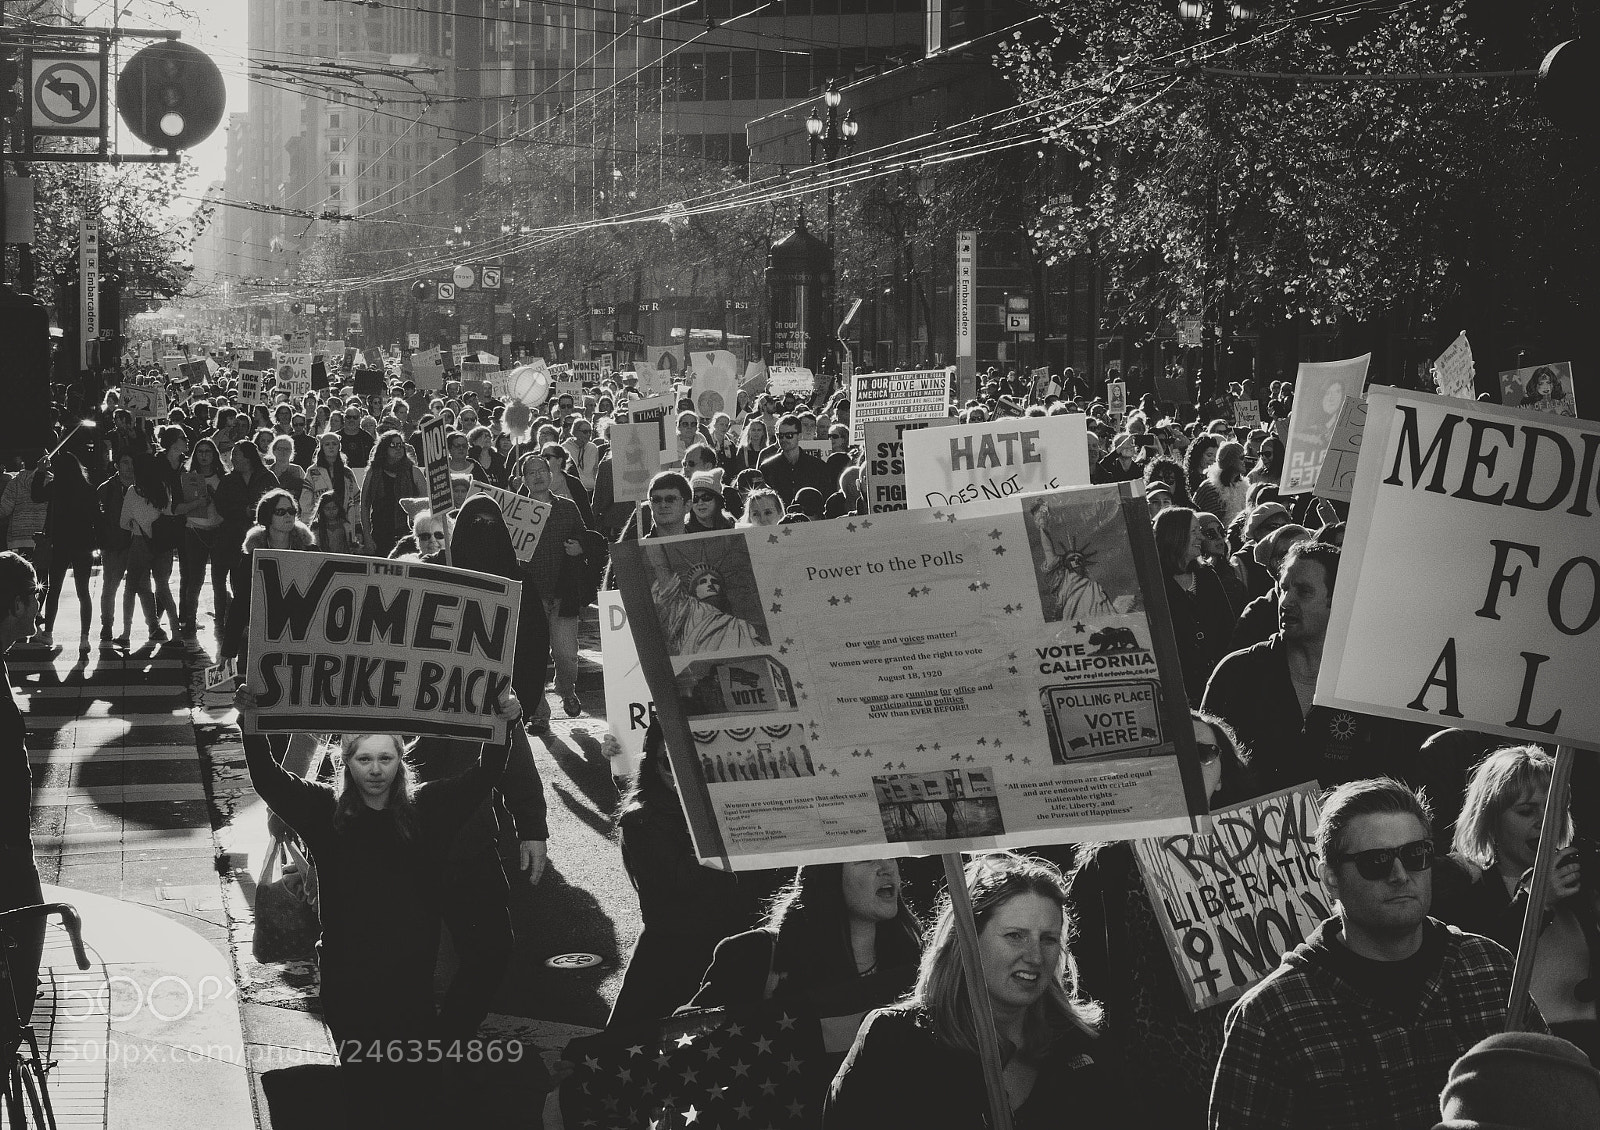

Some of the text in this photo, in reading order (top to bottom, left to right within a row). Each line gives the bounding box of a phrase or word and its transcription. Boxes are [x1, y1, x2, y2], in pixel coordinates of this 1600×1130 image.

[87, 272, 96, 333] Embarcadero
[962, 280, 970, 336] Embarcadero
[278, 355, 304, 365] SAVE
[574, 362, 600, 371] WOMEN
[241, 374, 259, 382] LOCK
[574, 372, 600, 382] UNITED
[858, 379, 889, 391] IN OUR
[890, 379, 946, 391] LOVE WINS
[243, 382, 257, 390] HIM
[857, 389, 888, 400] AMERICA
[856, 408, 894, 417] DISABILITIES
[911, 404, 943, 412] RESPECTED
[425, 425, 446, 464] NO!
[950, 430, 1041, 471] HATE
[872, 460, 888, 475] IS
[1383, 405, 1600, 517] MEDI
[981, 474, 1024, 500] NOT
[373, 562, 404, 576] THE
[805, 550, 964, 581] Power to the Polls
[257, 557, 510, 663] WOMEN
[845, 630, 958, 649] Our vote and voices matter!
[829, 659, 861, 668] Women
[884, 653, 916, 665] granted
[917, 652, 931, 660] the
[933, 650, 954, 660] right
[954, 649, 963, 657] to
[964, 647, 983, 655] vote
[1035, 643, 1086, 660] VOTE
[1039, 652, 1155, 675] CALIFORNIA
[256, 652, 511, 716] STRIKE BACK
[877, 670, 943, 683] August 18, 1920
[731, 688, 767, 706] VOTE
[836, 683, 993, 704] More women are running for office and
[1056, 690, 1151, 709] POLLING PLACE
[868, 703, 970, 720] NOW than EVER BEFORE!
[870, 695, 964, 712] participating in politics
[1084, 710, 1137, 730] VOTE
[1088, 727, 1140, 748] HERE
[1130, 770, 1153, 780] equal
[1023, 789, 1038, 797] and
[1053, 785, 1089, 794] endowed
[1090, 782, 1108, 791] with
[1045, 791, 1112, 803] inalienable rights
[762, 798, 783, 807] voting
[1069, 801, 1100, 811] Liberty,
[1101, 799, 1115, 807] and
[1051, 810, 1080, 819] Pursuit
[1162, 792, 1316, 882] RADICAL
[1164, 852, 1321, 930] LIBERATIO
